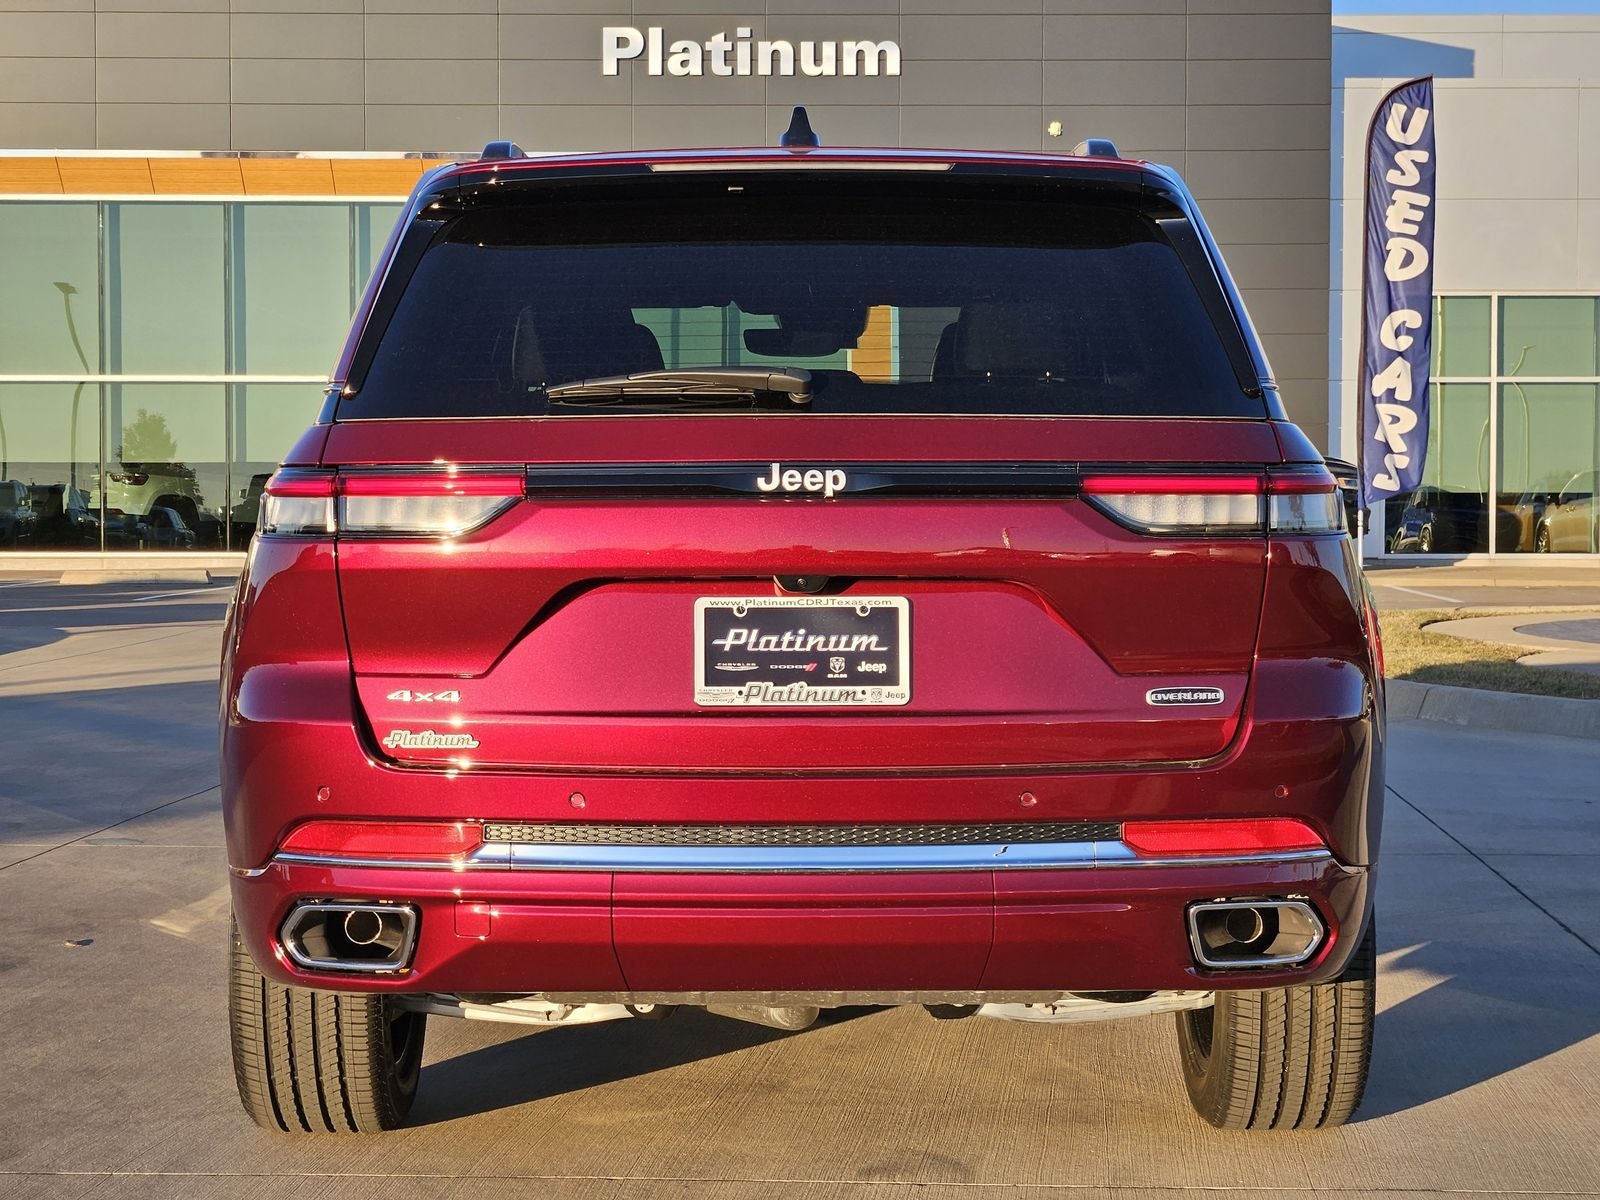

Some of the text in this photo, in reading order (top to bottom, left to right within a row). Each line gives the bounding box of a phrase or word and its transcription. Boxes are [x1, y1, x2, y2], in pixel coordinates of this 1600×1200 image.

[602, 26, 901, 77] Platinum
[1371, 102, 1431, 491] USED CARS
[757, 462, 847, 497] Jeep
[710, 598, 892, 606] www.PlatinumCDRJTexas.com
[712, 628, 888, 652] Platinum
[857, 661, 888, 674] Jeep
[386, 690, 461, 702] 4x4
[744, 685, 866, 704] Platinum
[885, 691, 906, 700] Jeep
[1151, 692, 1220, 701] OVERLAND
[383, 730, 479, 748] Platinum
